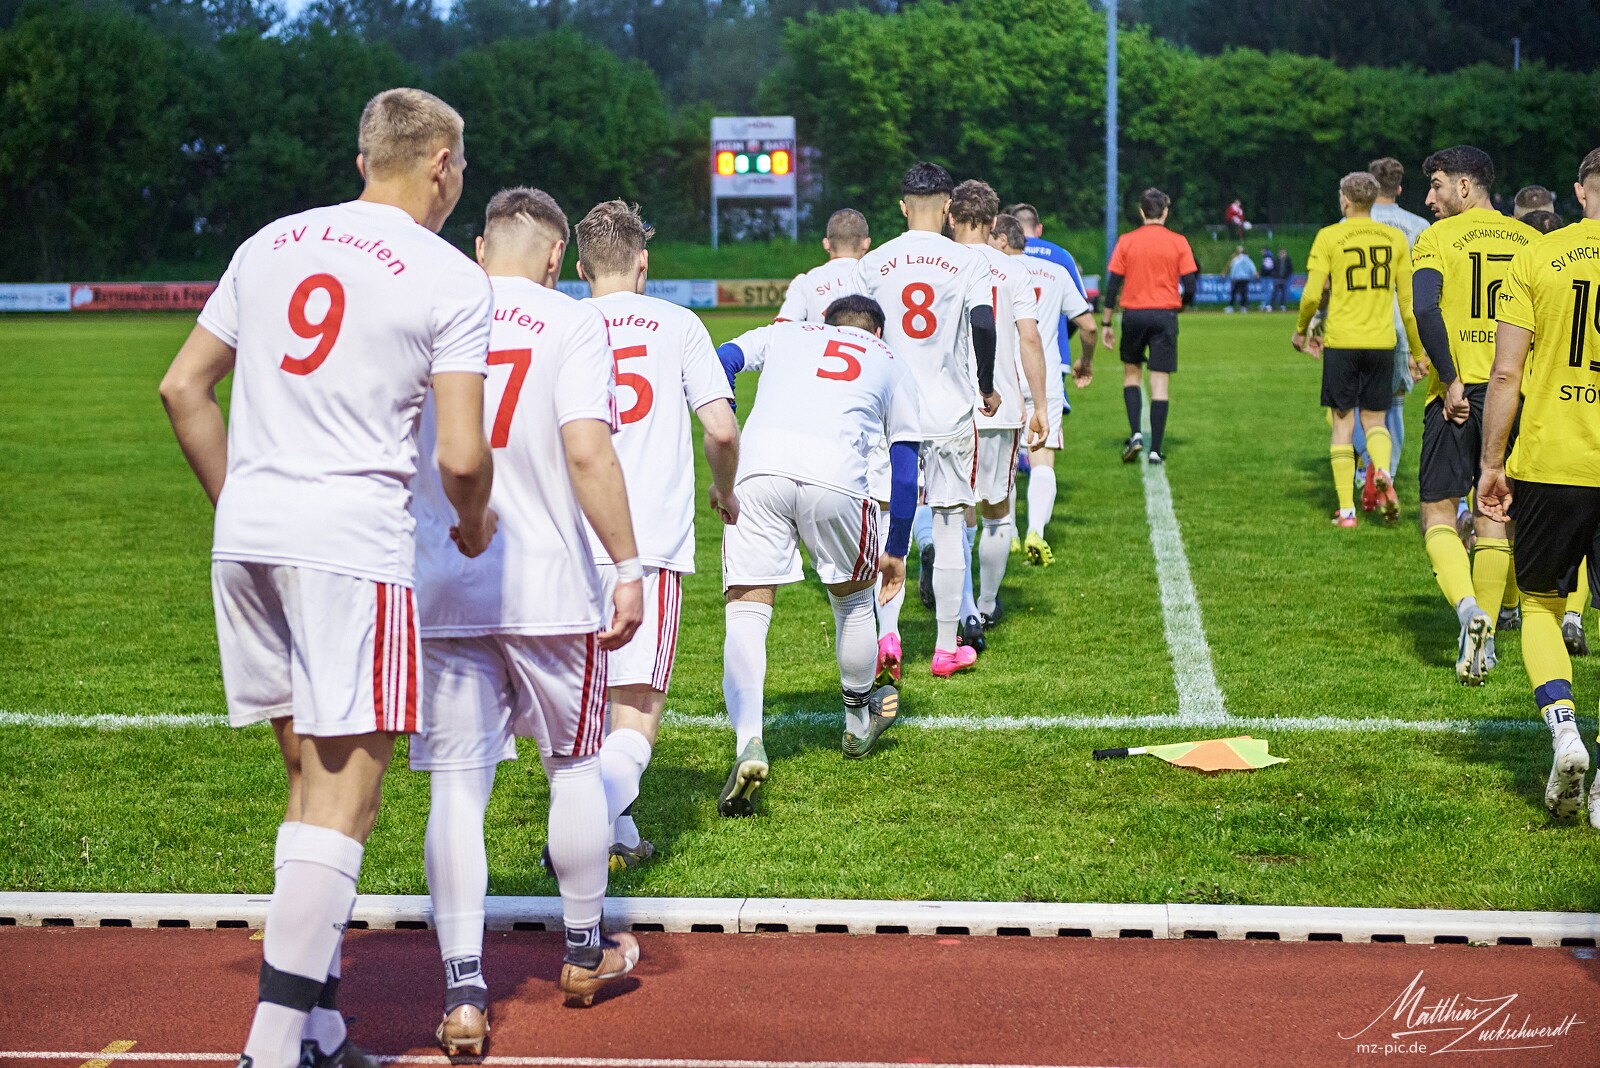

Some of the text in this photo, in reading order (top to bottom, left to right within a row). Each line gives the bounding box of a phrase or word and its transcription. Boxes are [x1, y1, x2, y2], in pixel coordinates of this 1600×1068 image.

[272, 225, 406, 276] SV Laufen
[1453, 238, 1466, 251] SV
[880, 254, 959, 276] SV Laufen
[1343, 245, 1393, 291] 28
[1551, 255, 1567, 272] SV
[815, 281, 831, 296] SV
[280, 272, 346, 376] 9
[494, 306, 546, 335] ufen
[901, 281, 938, 340] 8
[1569, 278, 1600, 373] 1
[1459, 329, 1497, 343] WIEDE
[815, 339, 867, 382] 5
[486, 347, 533, 449] 7
[1559, 383, 1600, 404] STÖ
